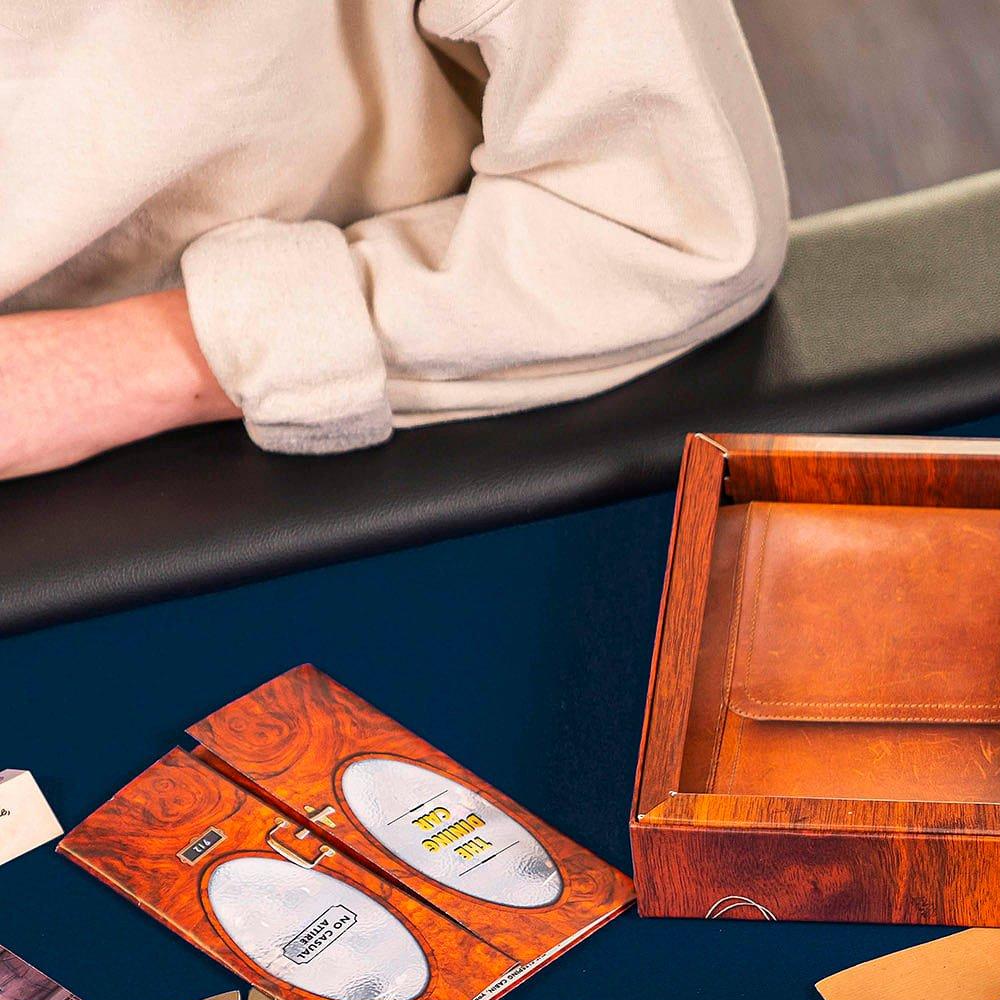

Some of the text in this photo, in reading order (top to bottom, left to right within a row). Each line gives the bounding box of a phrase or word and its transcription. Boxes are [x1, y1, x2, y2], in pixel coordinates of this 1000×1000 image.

[411, 806, 450, 830] CAR
[421, 812, 485, 852] DINING
[453, 836, 492, 860] THE
[296, 915, 350, 958] NO CASUAL
[299, 919, 328, 944] ATTIRE
